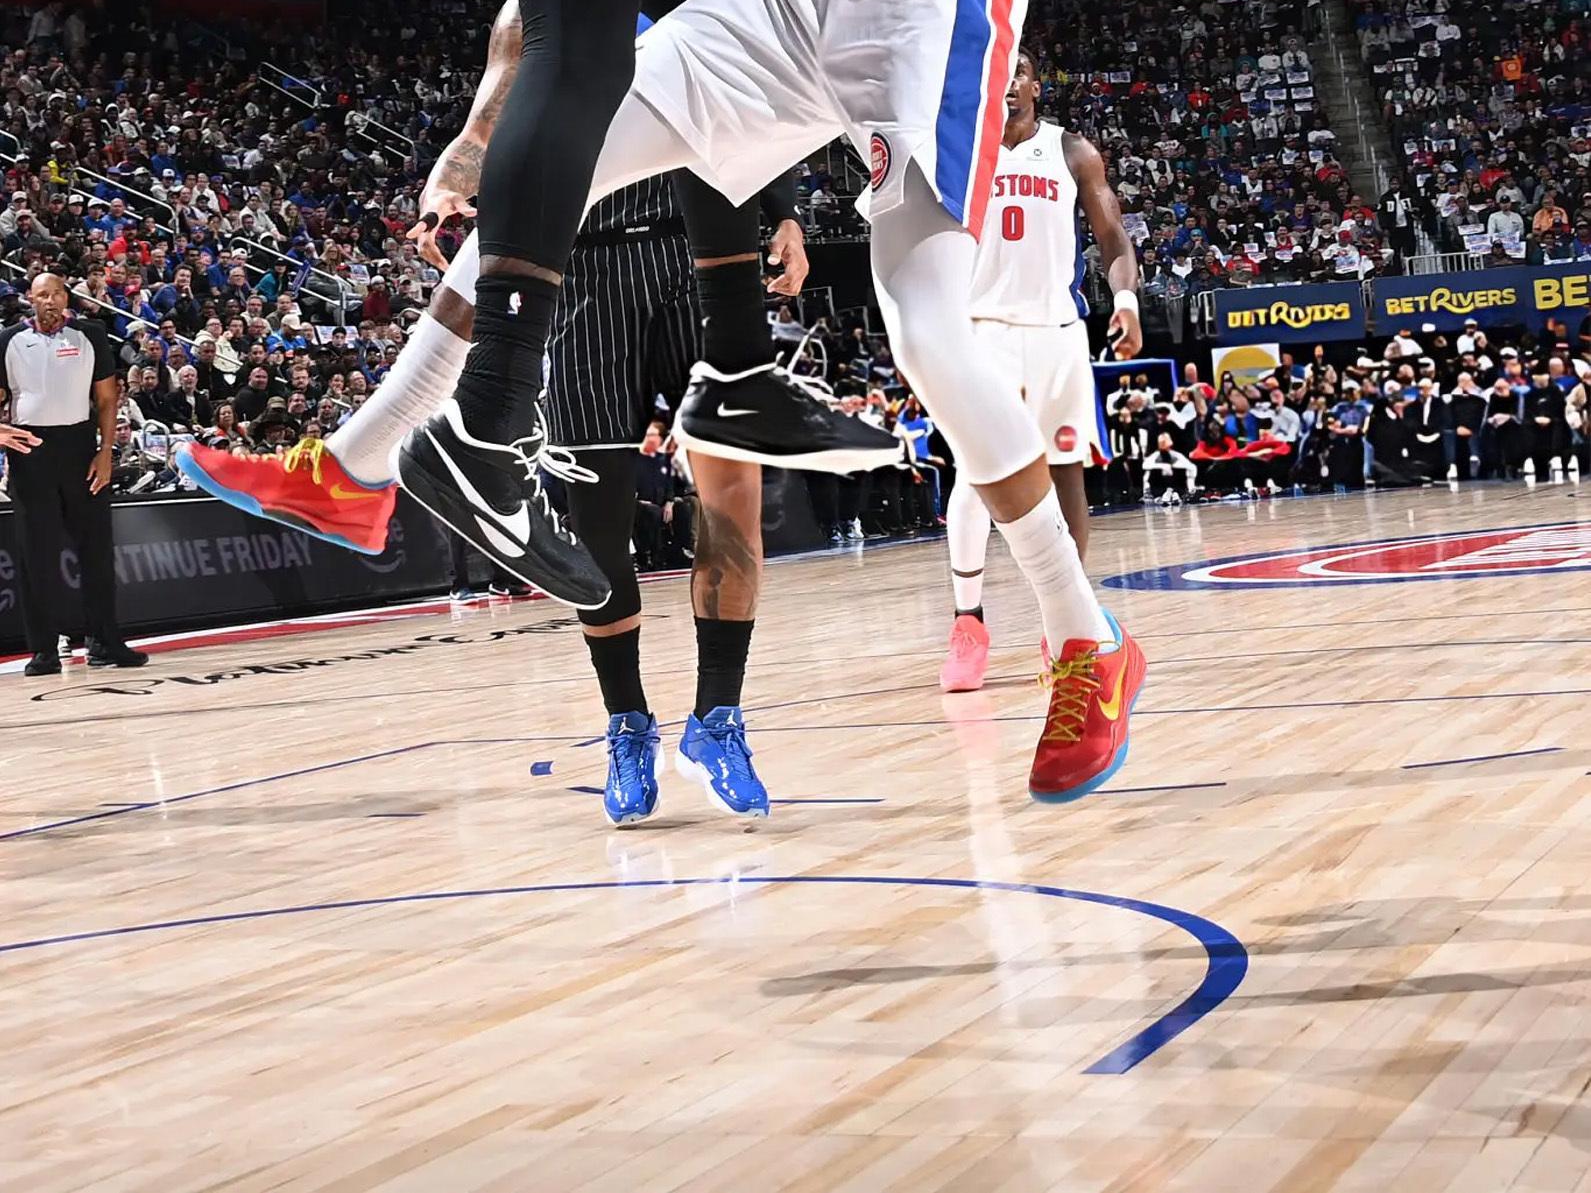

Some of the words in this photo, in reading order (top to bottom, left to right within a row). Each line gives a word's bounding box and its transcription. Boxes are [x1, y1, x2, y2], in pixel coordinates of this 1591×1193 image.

[1002, 206, 1024, 241] 0
[1533, 274, 1591, 310] BE
[215, 525, 313, 575] FRIDAY
